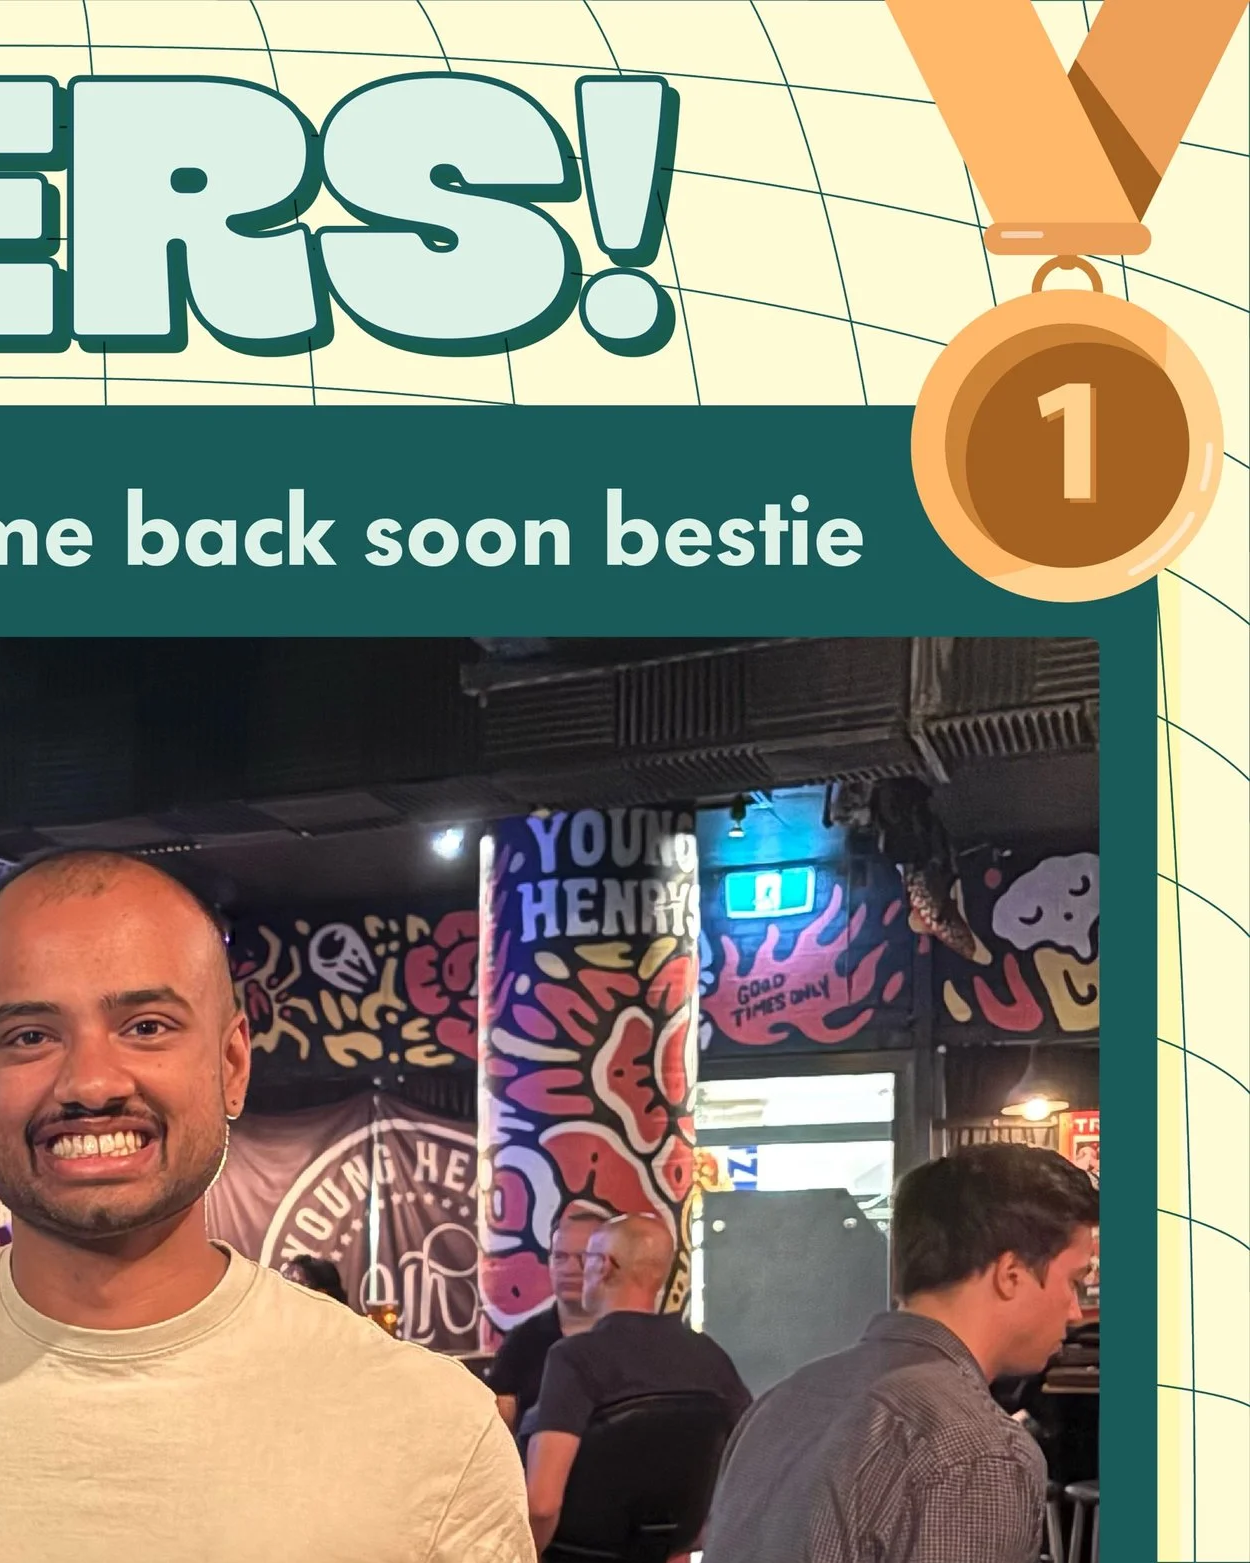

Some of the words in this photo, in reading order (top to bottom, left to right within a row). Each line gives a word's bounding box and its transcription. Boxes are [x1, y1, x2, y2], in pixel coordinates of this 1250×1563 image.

[525, 808, 698, 874] YOUNG
[730, 992, 786, 1027] TIMES
[790, 974, 830, 1004] ONLY
[737, 973, 785, 1005] GOOD
[280, 1142, 396, 1262] YOUNG
